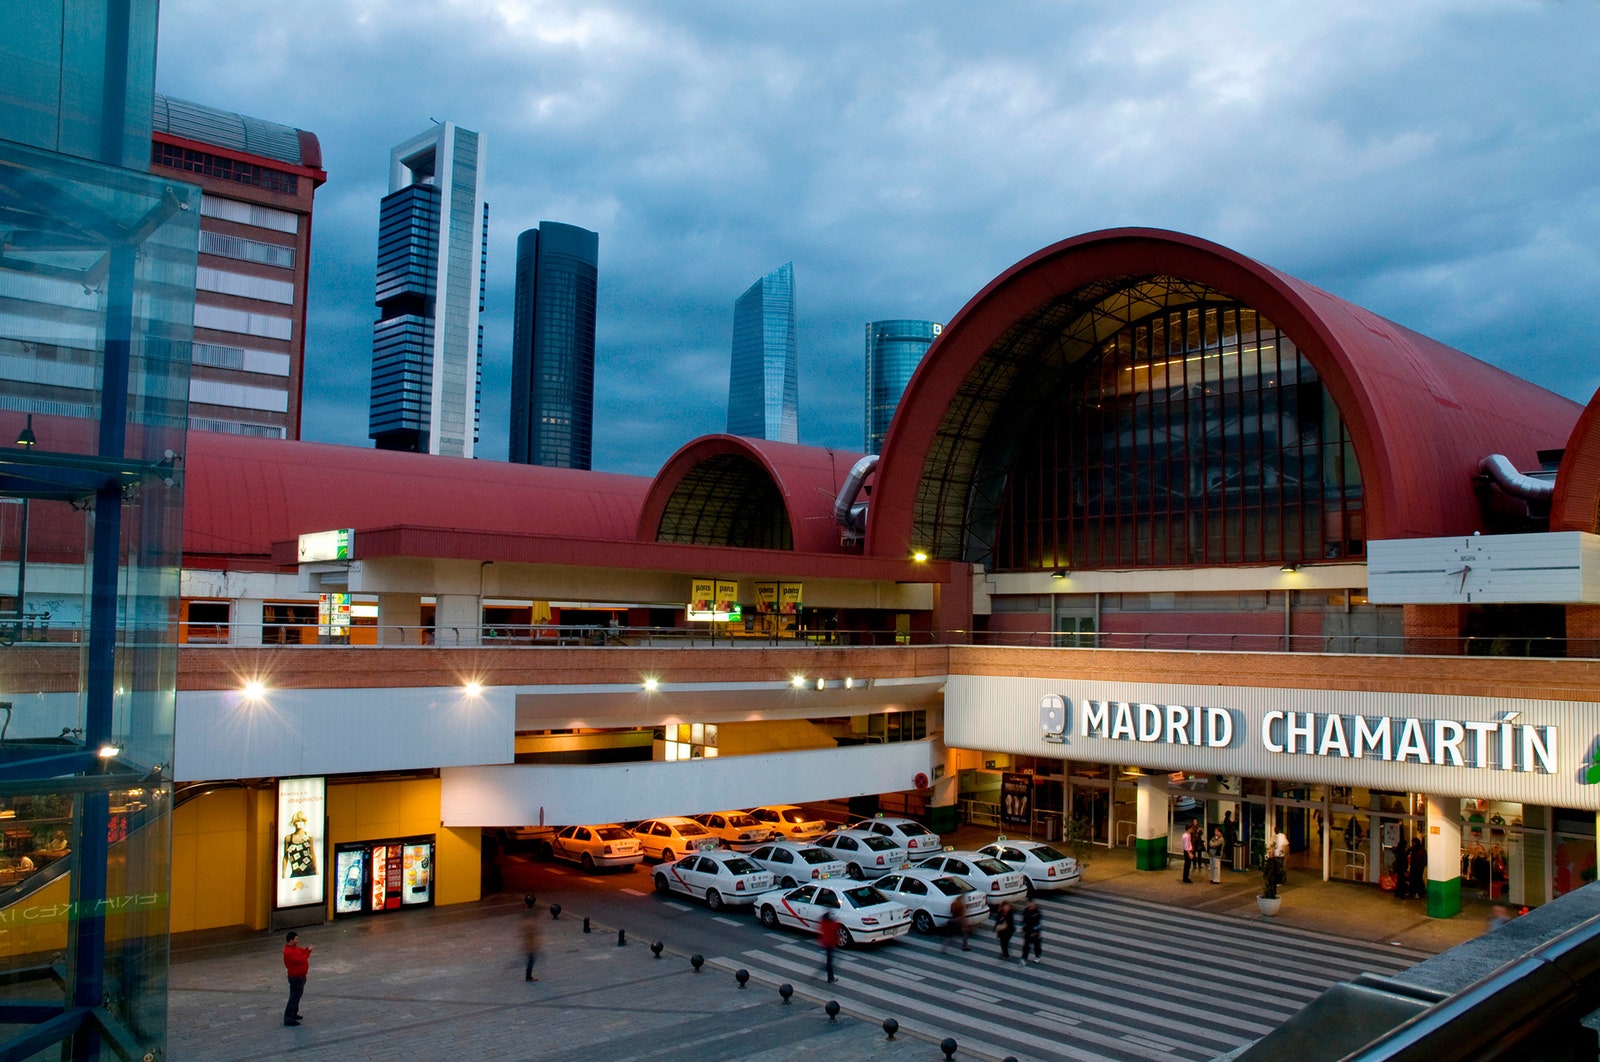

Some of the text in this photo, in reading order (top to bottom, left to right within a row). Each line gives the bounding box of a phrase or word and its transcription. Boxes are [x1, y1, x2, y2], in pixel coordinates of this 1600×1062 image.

[695, 584, 711, 592] pans
[719, 585, 734, 593] pans
[758, 587, 774, 595] pans
[783, 587, 799, 595] pans
[1081, 700, 1557, 773] MADRID CHAMARTÍN
